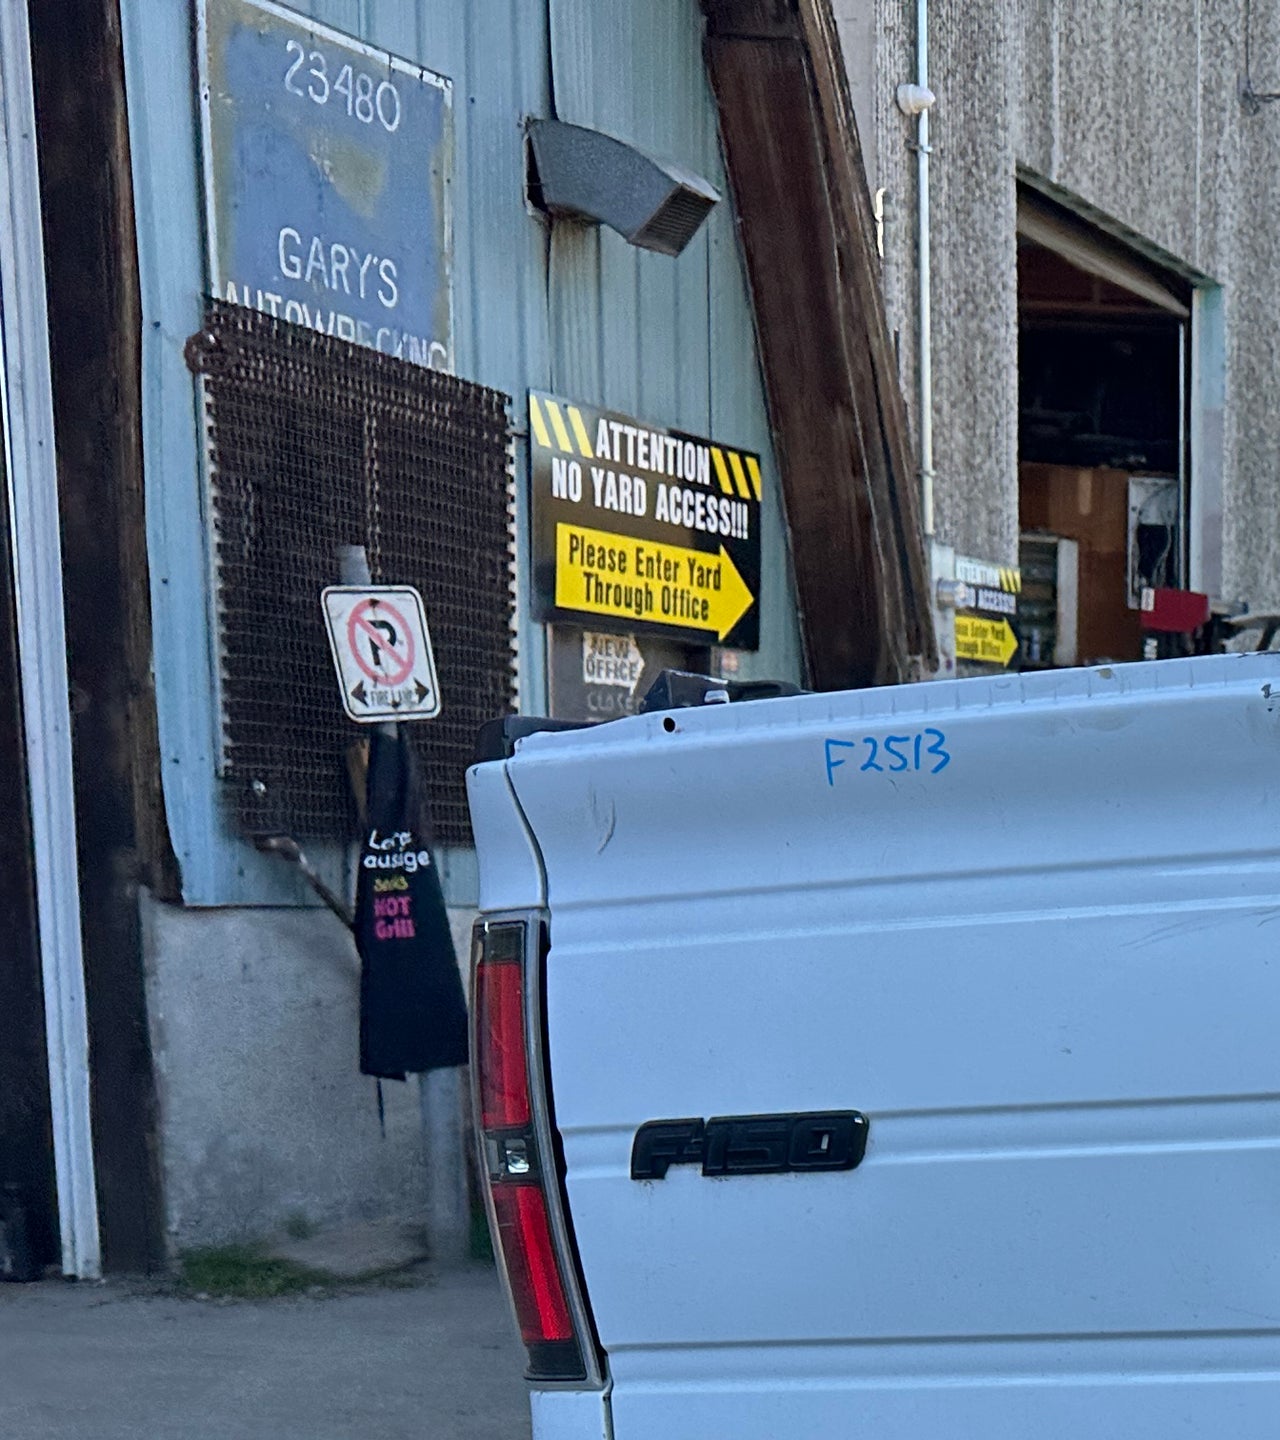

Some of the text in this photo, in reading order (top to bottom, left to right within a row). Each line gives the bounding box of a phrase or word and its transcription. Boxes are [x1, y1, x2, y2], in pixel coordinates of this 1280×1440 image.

[284, 39, 401, 132] 23480
[278, 227, 398, 308] GARY'S
[596, 417, 711, 486] ATTENTION
[551, 457, 749, 540] NO YARD ACCESS!!!
[569, 533, 722, 592] Please Enter Yard
[583, 572, 710, 621] Through Office
[586, 654, 640, 681] OFFICE
[825, 728, 951, 787] F2513
